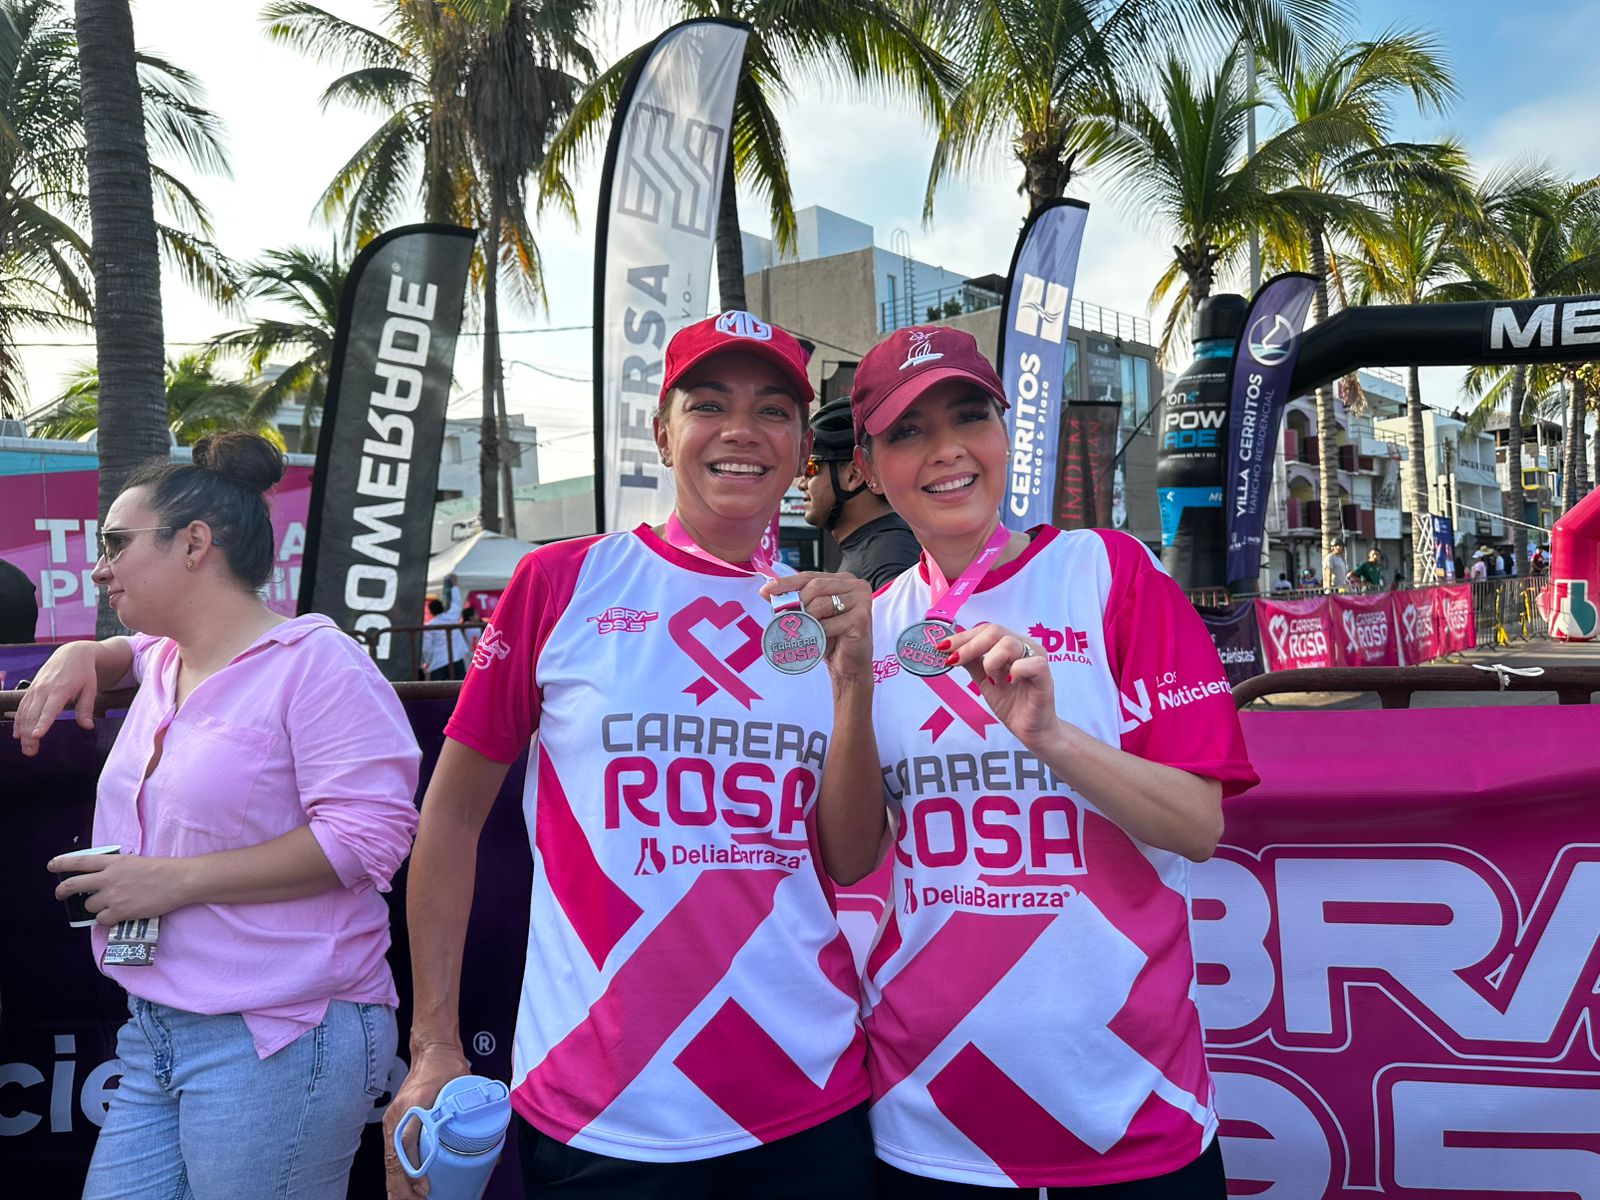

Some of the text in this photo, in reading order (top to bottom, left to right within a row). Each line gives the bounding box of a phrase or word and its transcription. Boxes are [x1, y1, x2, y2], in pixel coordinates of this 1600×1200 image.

[718, 310, 771, 340] MG
[620, 263, 671, 490] HERSA
[1037, 380, 1050, 424] Plaza
[1165, 410, 1226, 431] POW
[1238, 372, 1263, 462] CERRITOS
[1010, 351, 1041, 518] CERRITOS
[1164, 429, 1217, 449] ADE
[1248, 388, 1275, 515] RANCHO RESIDENCIAL
[345, 273, 438, 660] POWERADE
[1236, 468, 1250, 518] VILLA
[599, 620, 645, 634] 99.5
[1041, 626, 1089, 654] DIF
[1357, 624, 1388, 648] ROSA
[772, 637, 817, 652] CARRERA
[773, 645, 819, 665] ROSA
[900, 647, 947, 669] ROSA
[1289, 632, 1328, 658] ROSA
[1048, 653, 1093, 666] INALOA
[602, 713, 828, 770] CARRERA
[604, 757, 817, 834] ROSA
